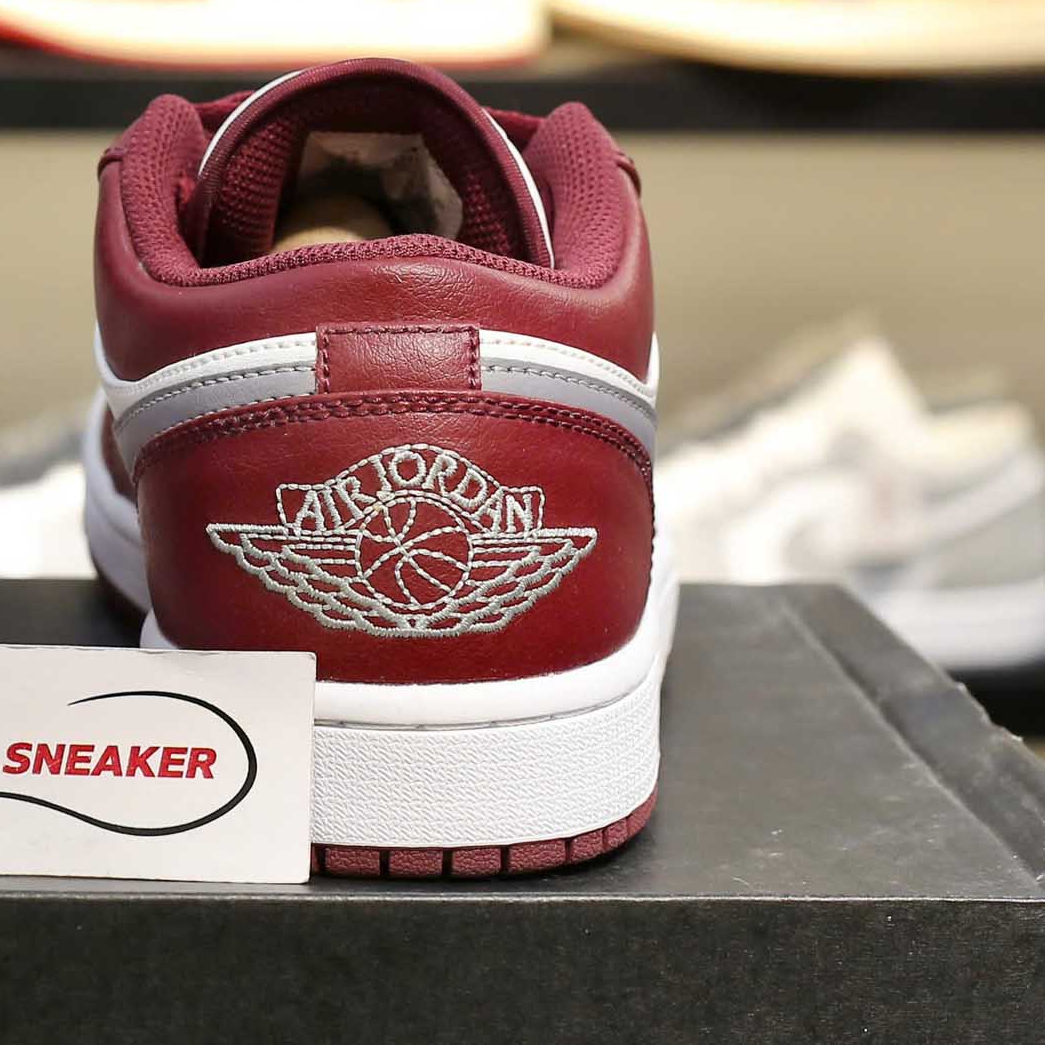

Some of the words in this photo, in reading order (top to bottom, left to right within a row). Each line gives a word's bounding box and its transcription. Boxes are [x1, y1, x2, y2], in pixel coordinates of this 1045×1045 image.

[293, 476, 375, 534] AIR
[369, 451, 533, 537] JORDAN
[2, 741, 217, 779] SNEAKER
